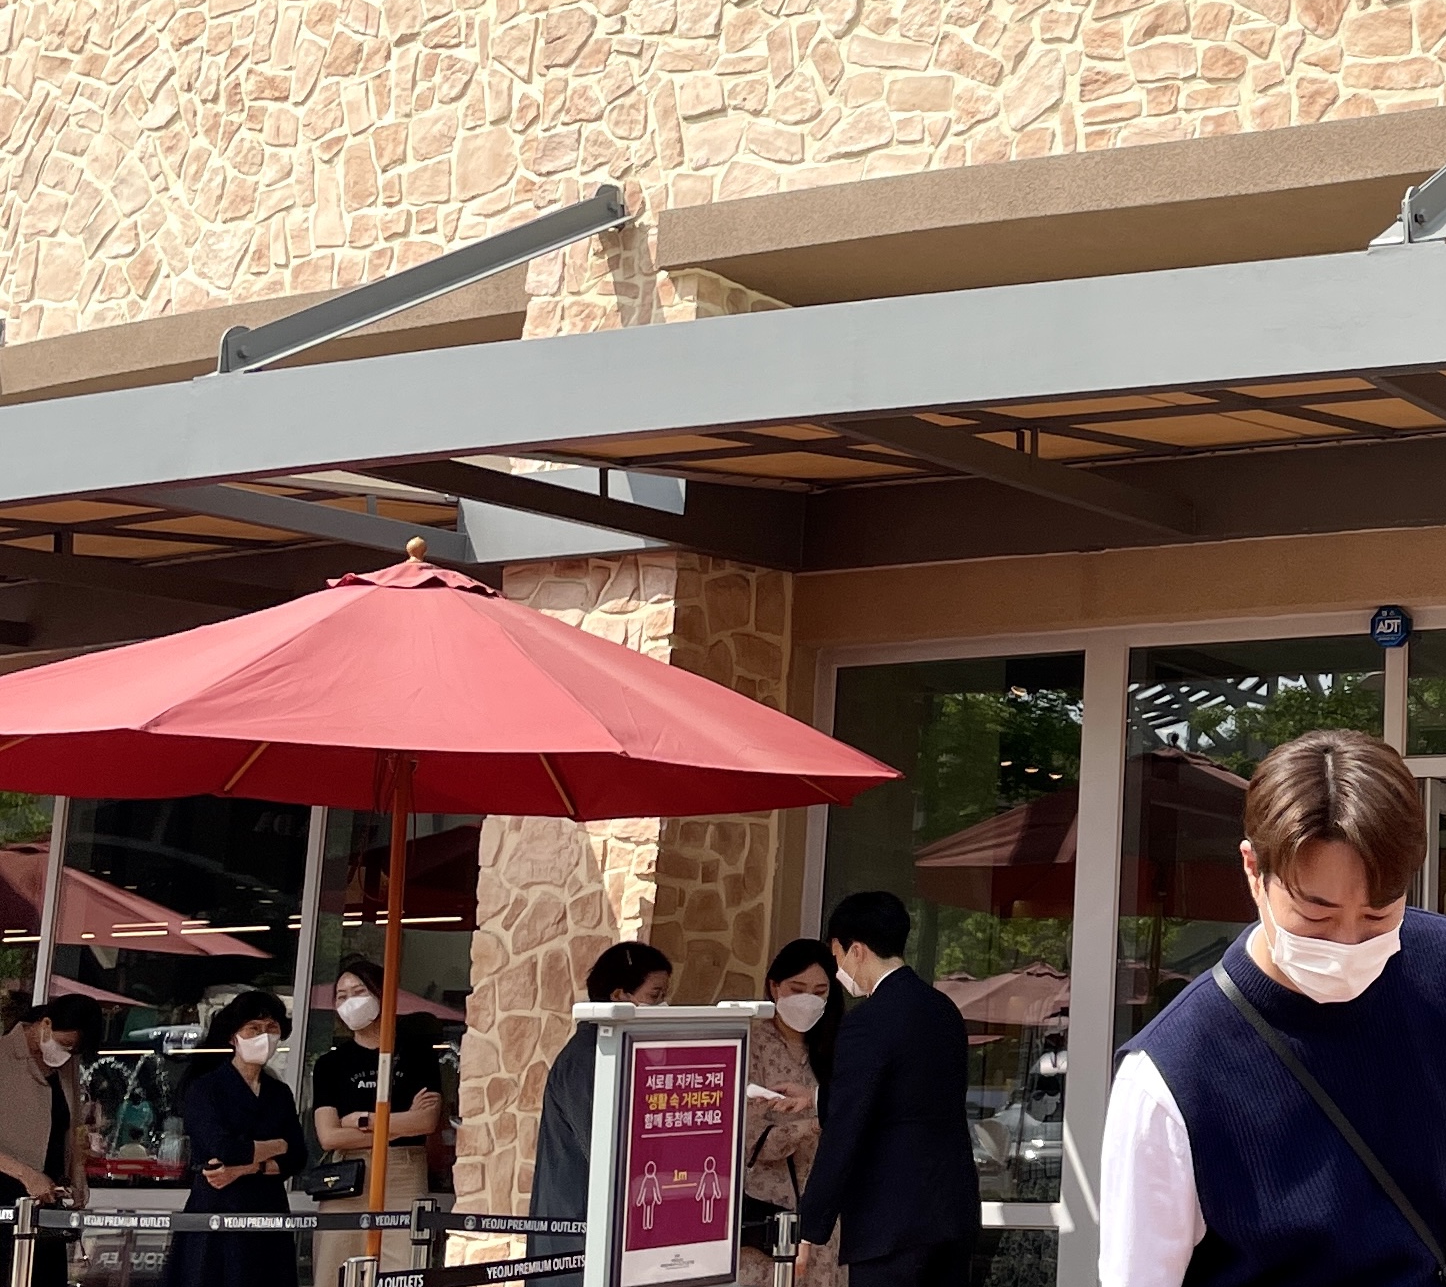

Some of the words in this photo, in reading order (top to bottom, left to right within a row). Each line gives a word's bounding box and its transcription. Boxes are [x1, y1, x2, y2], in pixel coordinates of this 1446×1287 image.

[1376, 619, 1402, 634] ADT
[645, 1073, 674, 1090] 서로를
[675, 1073, 704, 1089] 지키는
[704, 1071, 724, 1088] 거리
[669, 1092, 680, 1109] 속
[644, 1113, 663, 1130] 함께
[664, 1111, 692, 1128] 동참해
[694, 1109, 722, 1126] 주세요
[673, 1169, 688, 1182] 1m
[84, 1215, 104, 1226] YEOJU
[104, 1215, 138, 1227] PREMIUM
[140, 1216, 171, 1228] OUTLETS
[223, 1217, 247, 1228] YEOJU
[247, 1216, 283, 1228] PREMIUM
[285, 1216, 318, 1228] OUTLETS
[375, 1215, 399, 1226] YEOJU
[481, 1218, 507, 1229] YEOJU
[507, 1219, 548, 1231] PREMIUM
[550, 1221, 587, 1233] OUTLETS
[486, 1263, 513, 1279] YEOJU
[513, 1259, 552, 1276] PREMIUM
